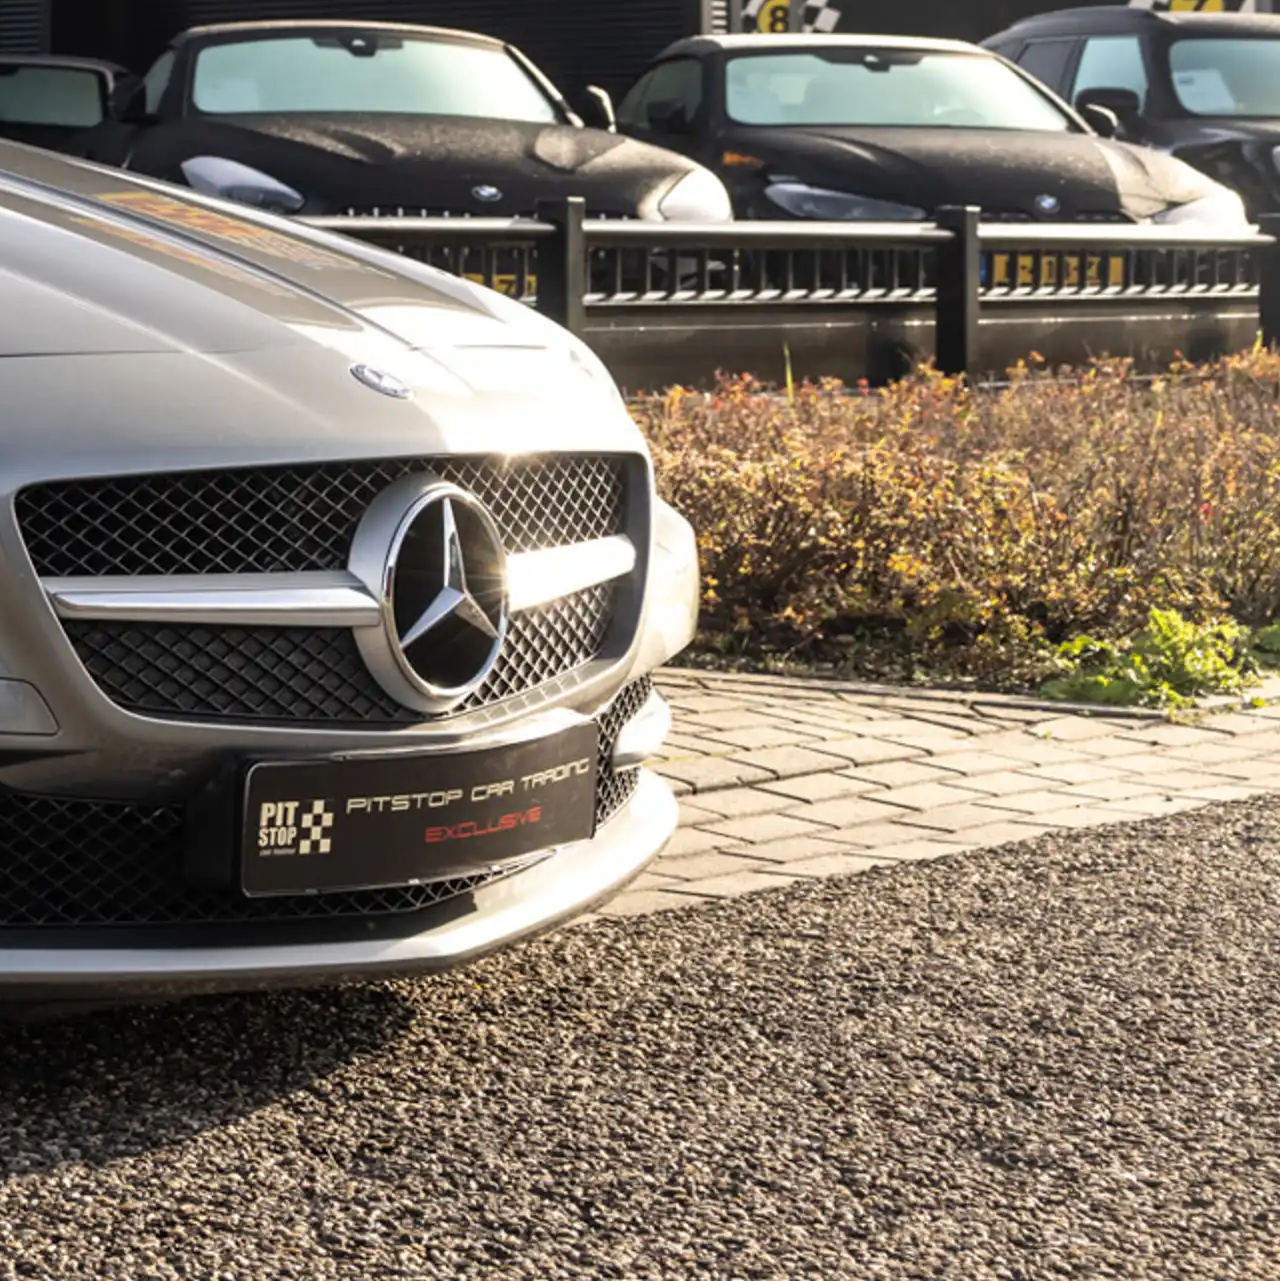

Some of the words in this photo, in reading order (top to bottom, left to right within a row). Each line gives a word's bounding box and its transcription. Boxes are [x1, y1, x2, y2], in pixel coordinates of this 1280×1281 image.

[346, 788, 464, 814] PITSTOP
[471, 779, 515, 802] CAR
[521, 757, 590, 791] TRADING
[260, 801, 299, 827] PIT
[425, 805, 543, 843] EXCLUSIVE
[258, 826, 297, 847] STOP
